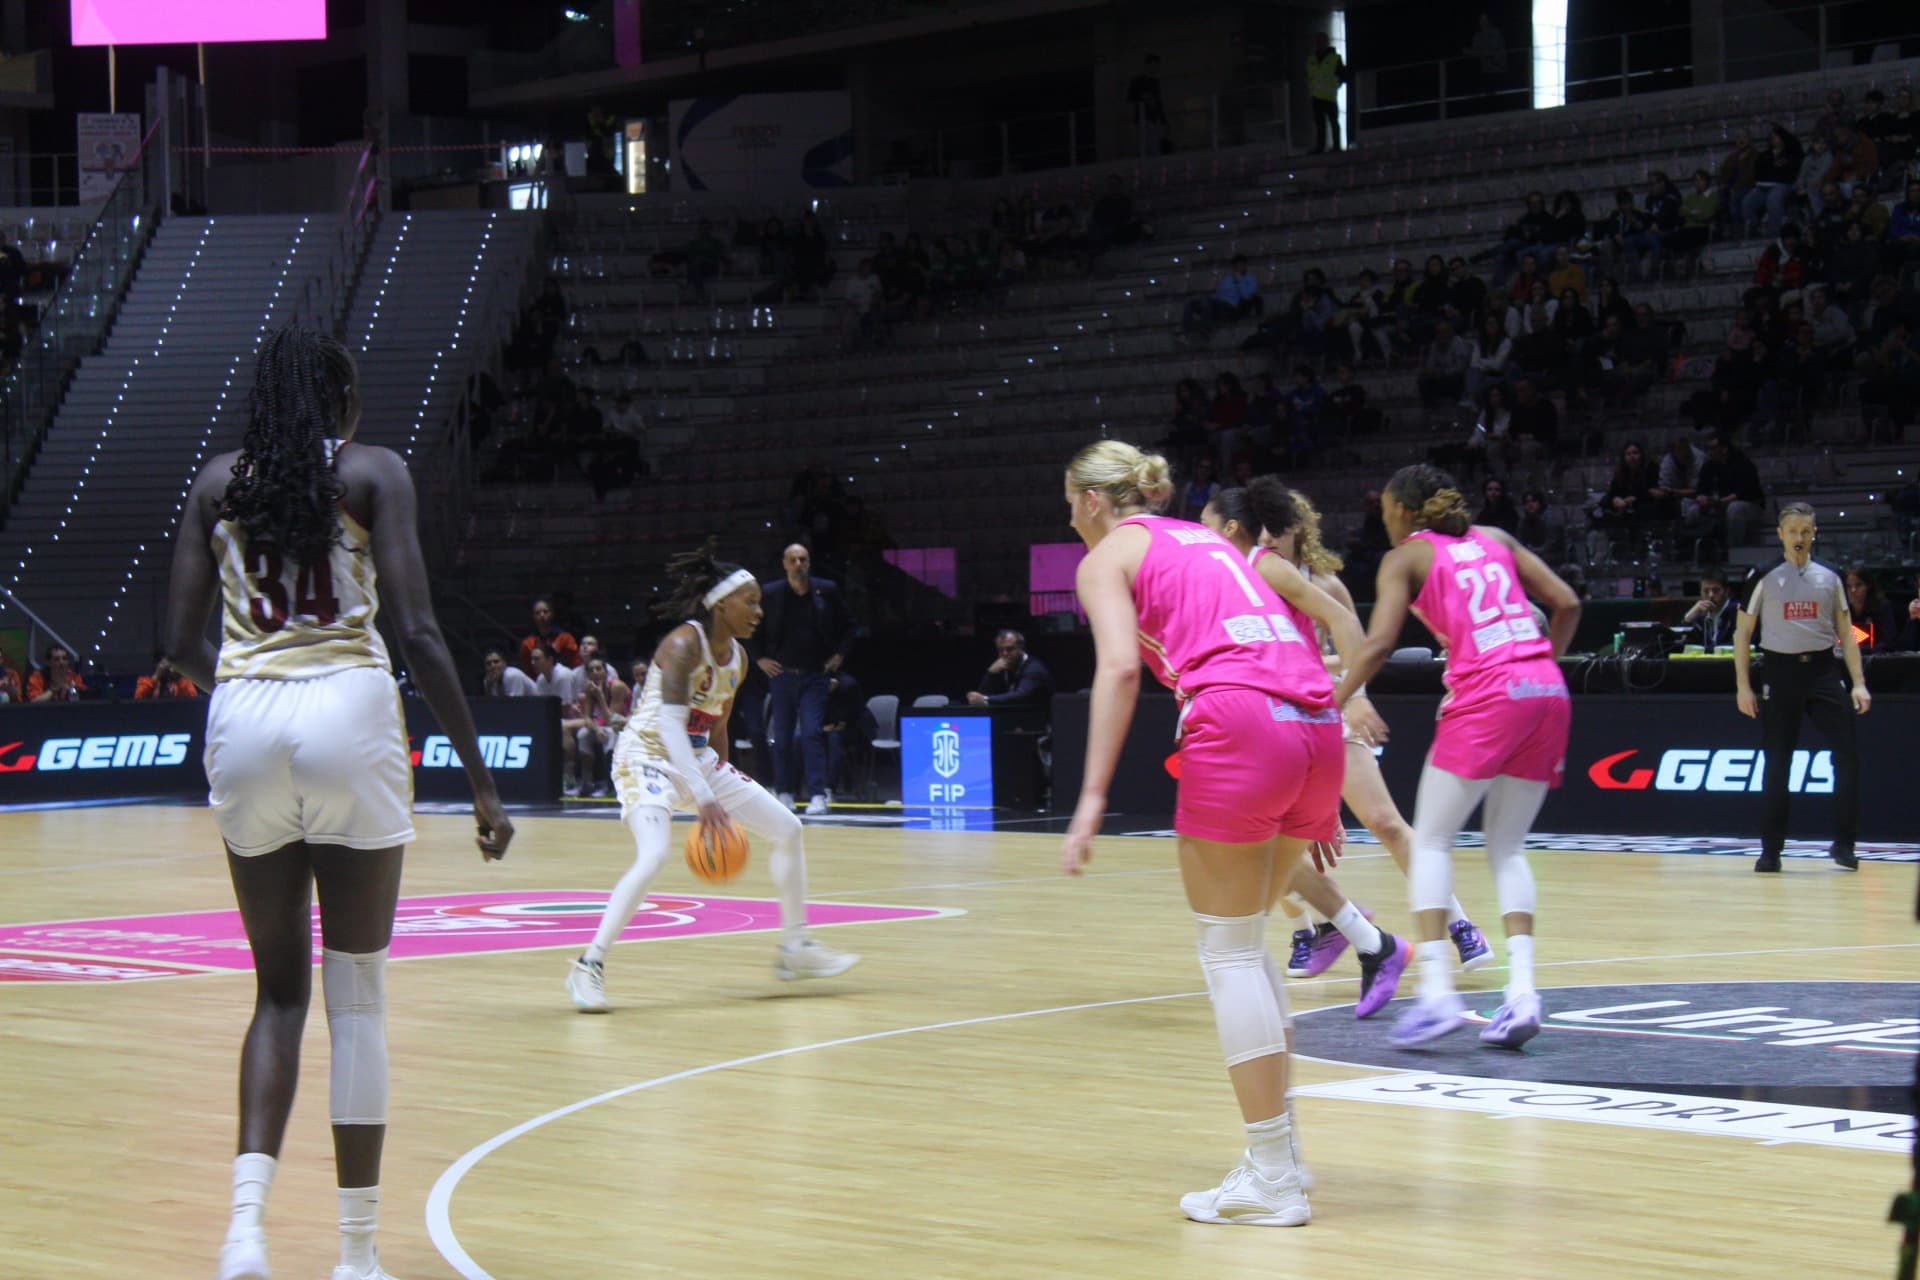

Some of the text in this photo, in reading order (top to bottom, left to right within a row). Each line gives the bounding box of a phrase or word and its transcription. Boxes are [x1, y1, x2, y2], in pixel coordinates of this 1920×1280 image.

[244, 541, 340, 634] 34
[1208, 551, 1264, 607] 1
[1454, 561, 1524, 625] 22
[37, 733, 192, 771] GEMS
[421, 735, 533, 769] GMS
[929, 784, 966, 803] FIP
[1371, 1081, 1789, 1123] SCOPRI
